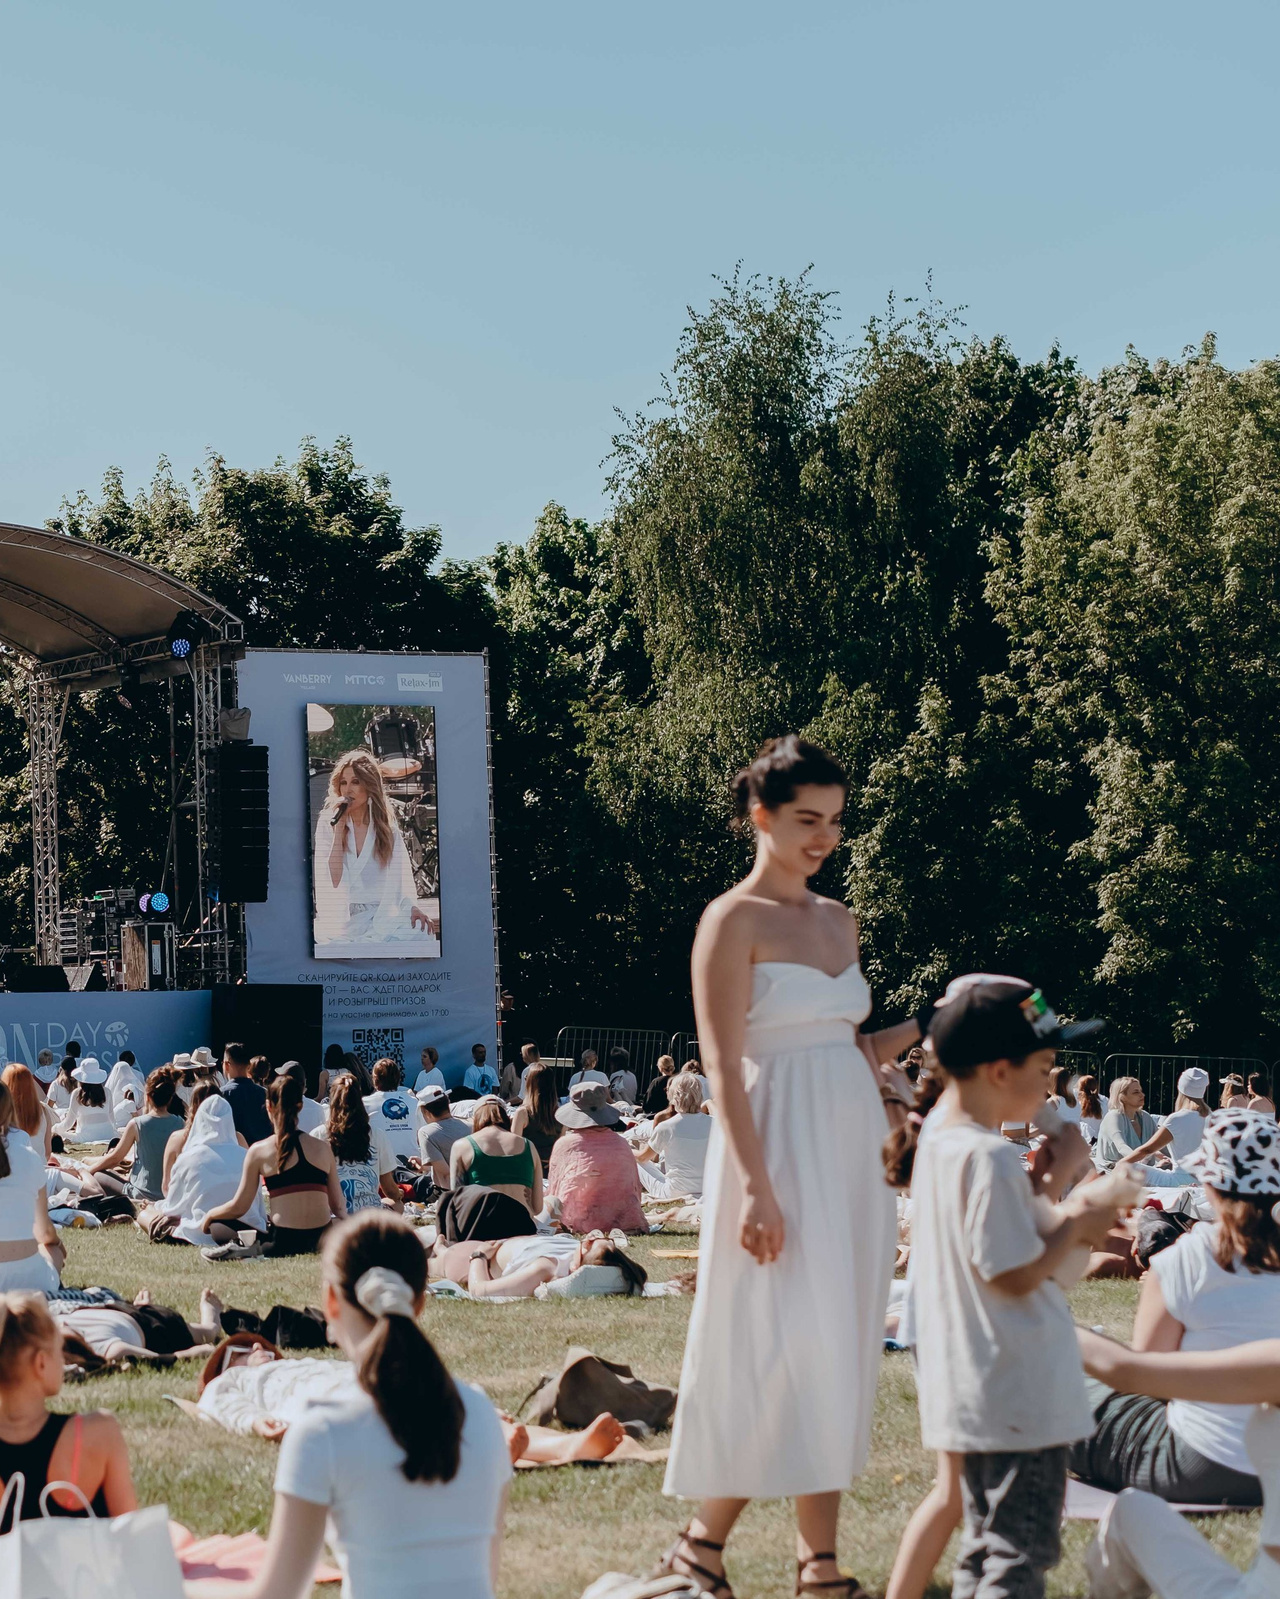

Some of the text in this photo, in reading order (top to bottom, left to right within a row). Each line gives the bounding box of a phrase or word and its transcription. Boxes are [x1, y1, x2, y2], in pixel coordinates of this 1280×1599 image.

[283, 673, 332, 684] VANBERRY
[297, 972, 358, 983] СКАНИРУЙТЕ
[397, 973, 405, 982] И
[407, 972, 452, 982] ЗАХОДИТЕ
[322, 985, 337, 994] ОТ
[350, 985, 370, 994] ВАС
[372, 985, 396, 995] ЖДЕТ
[397, 984, 442, 994] ПОДАРОК
[328, 996, 427, 1006] И РОЗЫГРЫШ ПРИЗОВ
[340, 1011, 370, 1021] участие
[372, 1011, 418, 1020] принимаем
[420, 1010, 429, 1018] до
[431, 1009, 450, 1017] 17:00
[47, 1021, 102, 1047] DAY
